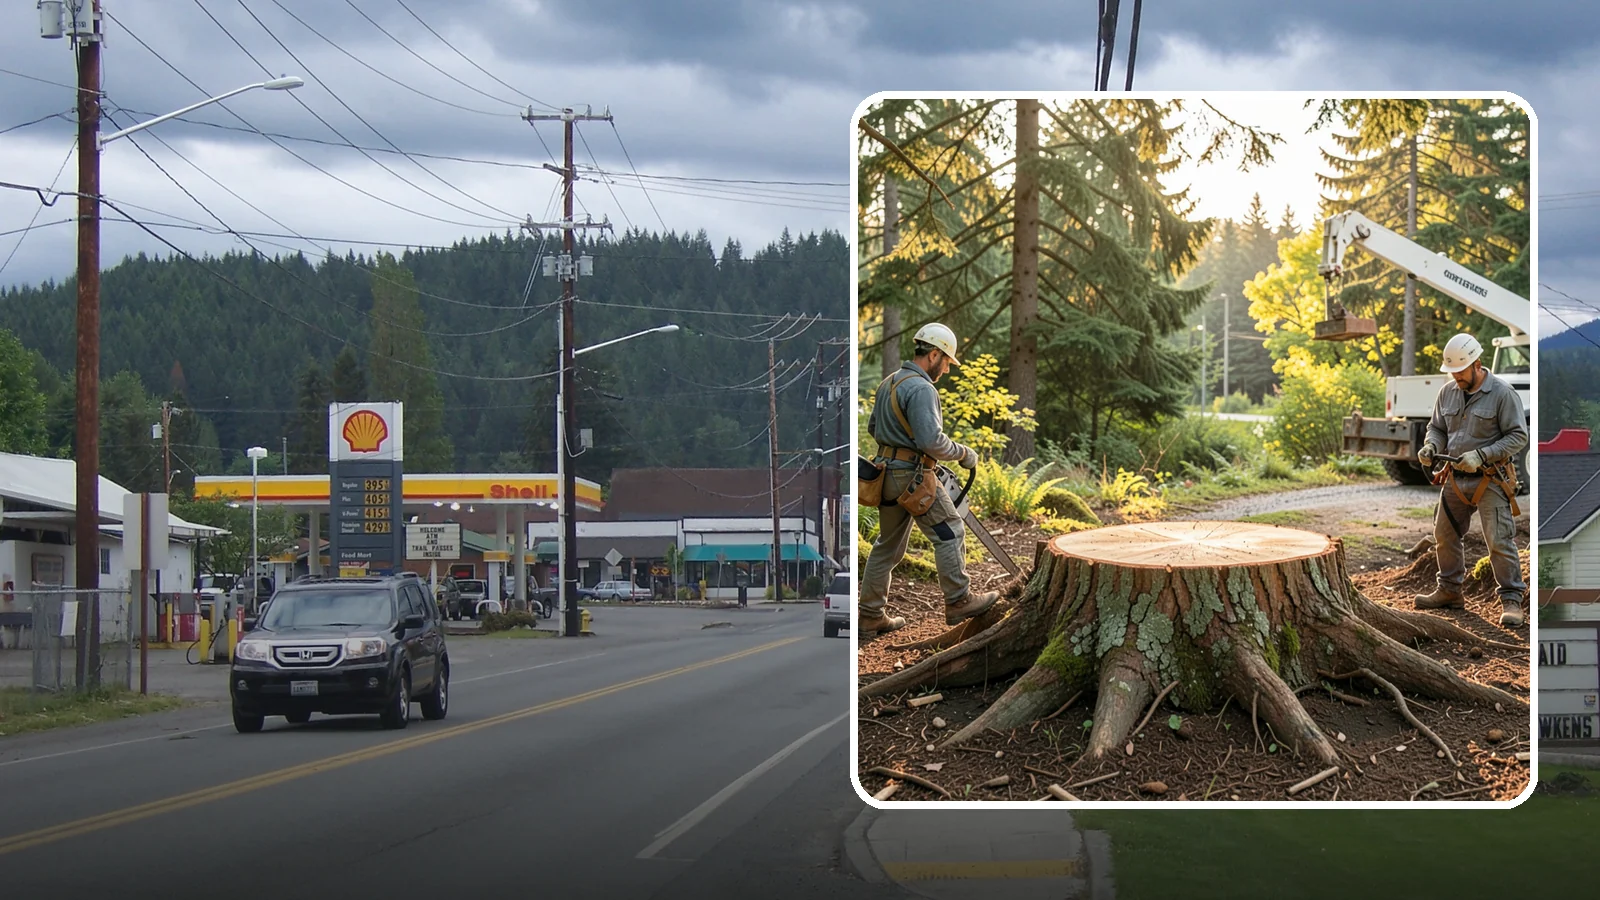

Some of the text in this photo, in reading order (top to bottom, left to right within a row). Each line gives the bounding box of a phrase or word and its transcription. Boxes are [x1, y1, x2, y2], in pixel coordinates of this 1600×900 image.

[366, 480, 383, 490] 395
[490, 484, 547, 499] Shell
[366, 494, 383, 504] 405
[366, 508, 383, 518] 415
[366, 522, 383, 532] 429
[1538, 643, 1566, 666] AID
